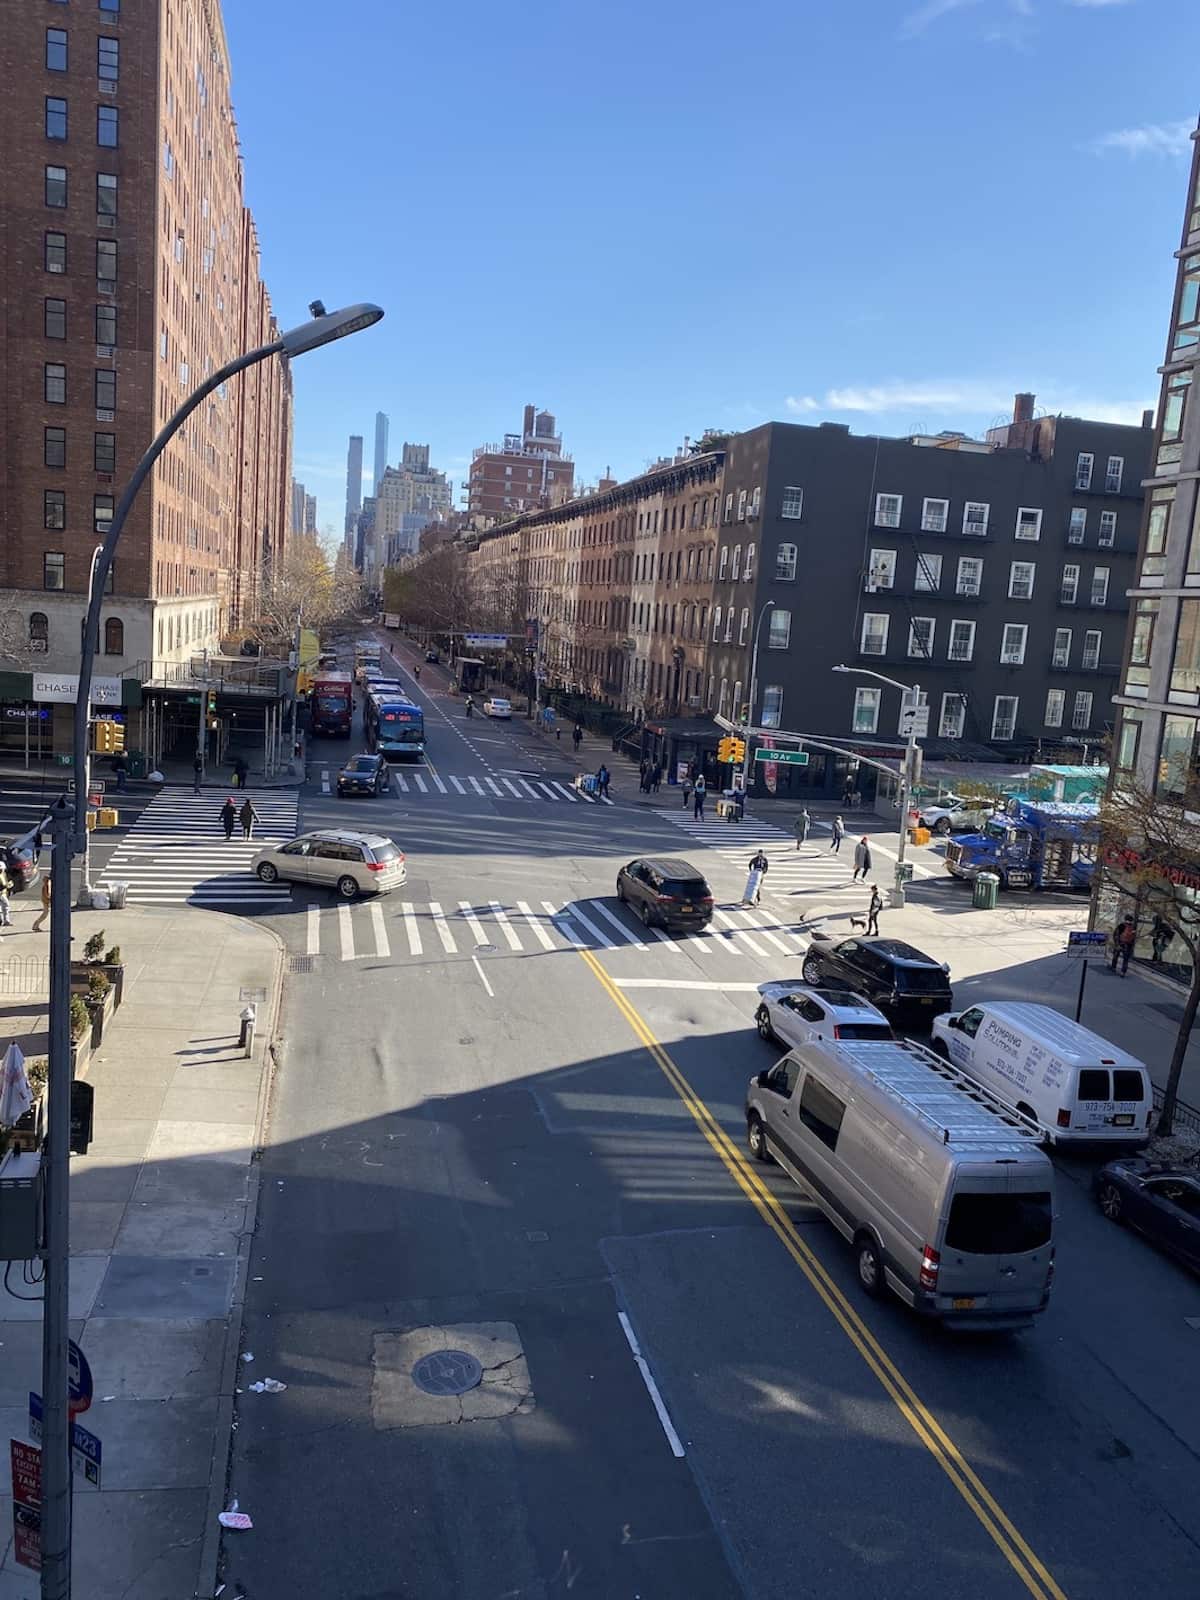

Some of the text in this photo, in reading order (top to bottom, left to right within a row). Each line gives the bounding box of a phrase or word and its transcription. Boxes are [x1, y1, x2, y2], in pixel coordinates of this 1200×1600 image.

[36, 683, 77, 693] CHASE
[770, 752, 791, 761] 10 Av
[988, 1020, 1022, 1048] PUMPING
[73, 1430, 97, 1457] M23
